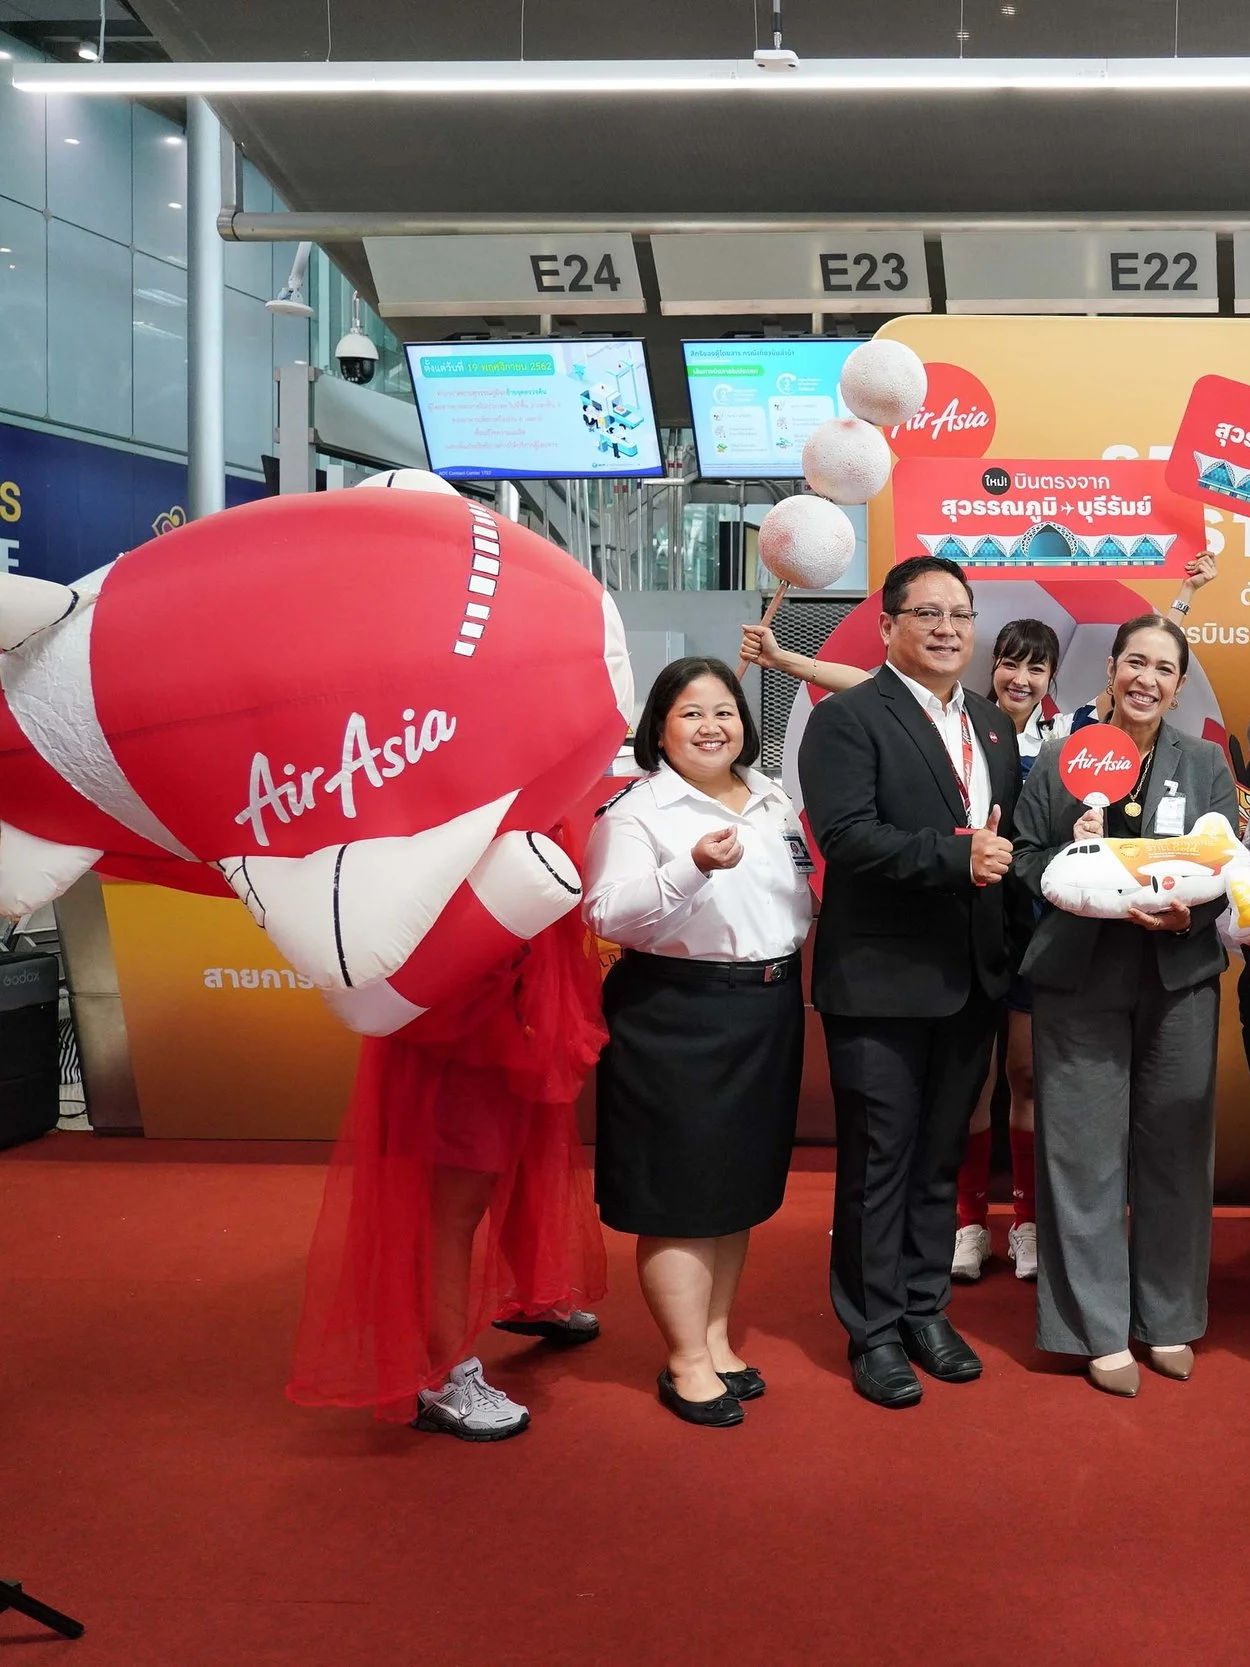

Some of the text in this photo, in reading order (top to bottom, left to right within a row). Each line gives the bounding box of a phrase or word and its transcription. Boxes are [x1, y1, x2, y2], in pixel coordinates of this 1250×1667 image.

[530, 253, 621, 293] E24
[820, 253, 910, 293] E23
[1111, 252, 1199, 292] E22
[467, 363, 478, 372] 19
[530, 361, 552, 371] 2562
[984, 472, 1111, 490] ใหม่! บินตรงจาก
[941, 494, 1153, 524] สุวรรณภูมิ บุรีรัมย์
[235, 708, 457, 847] AirAsia
[1066, 746, 1133, 777] AirAsia
